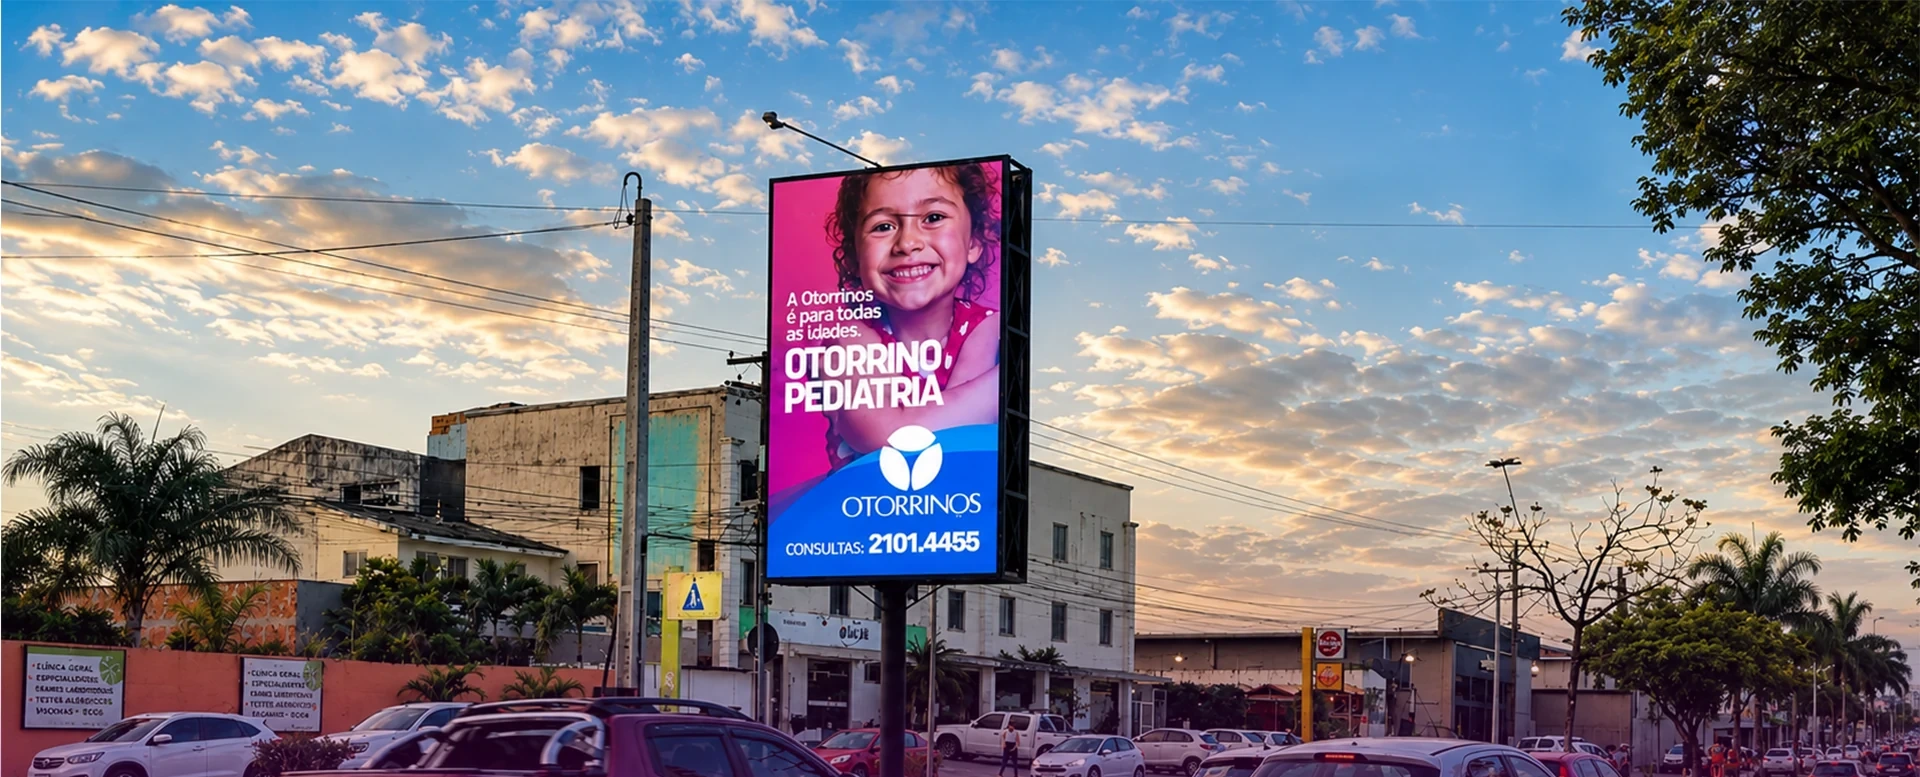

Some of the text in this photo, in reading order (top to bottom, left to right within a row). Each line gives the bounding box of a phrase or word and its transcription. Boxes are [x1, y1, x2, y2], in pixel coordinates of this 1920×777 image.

[786, 288, 874, 307] A Otorrinos
[786, 304, 882, 328] é para todas
[786, 329, 804, 342] as
[785, 339, 942, 380] OTORRINO
[784, 374, 945, 413] PEDIATRIA
[841, 492, 982, 518] OTORRINOS
[785, 530, 981, 556] CONSULTAS: 2101.4455
